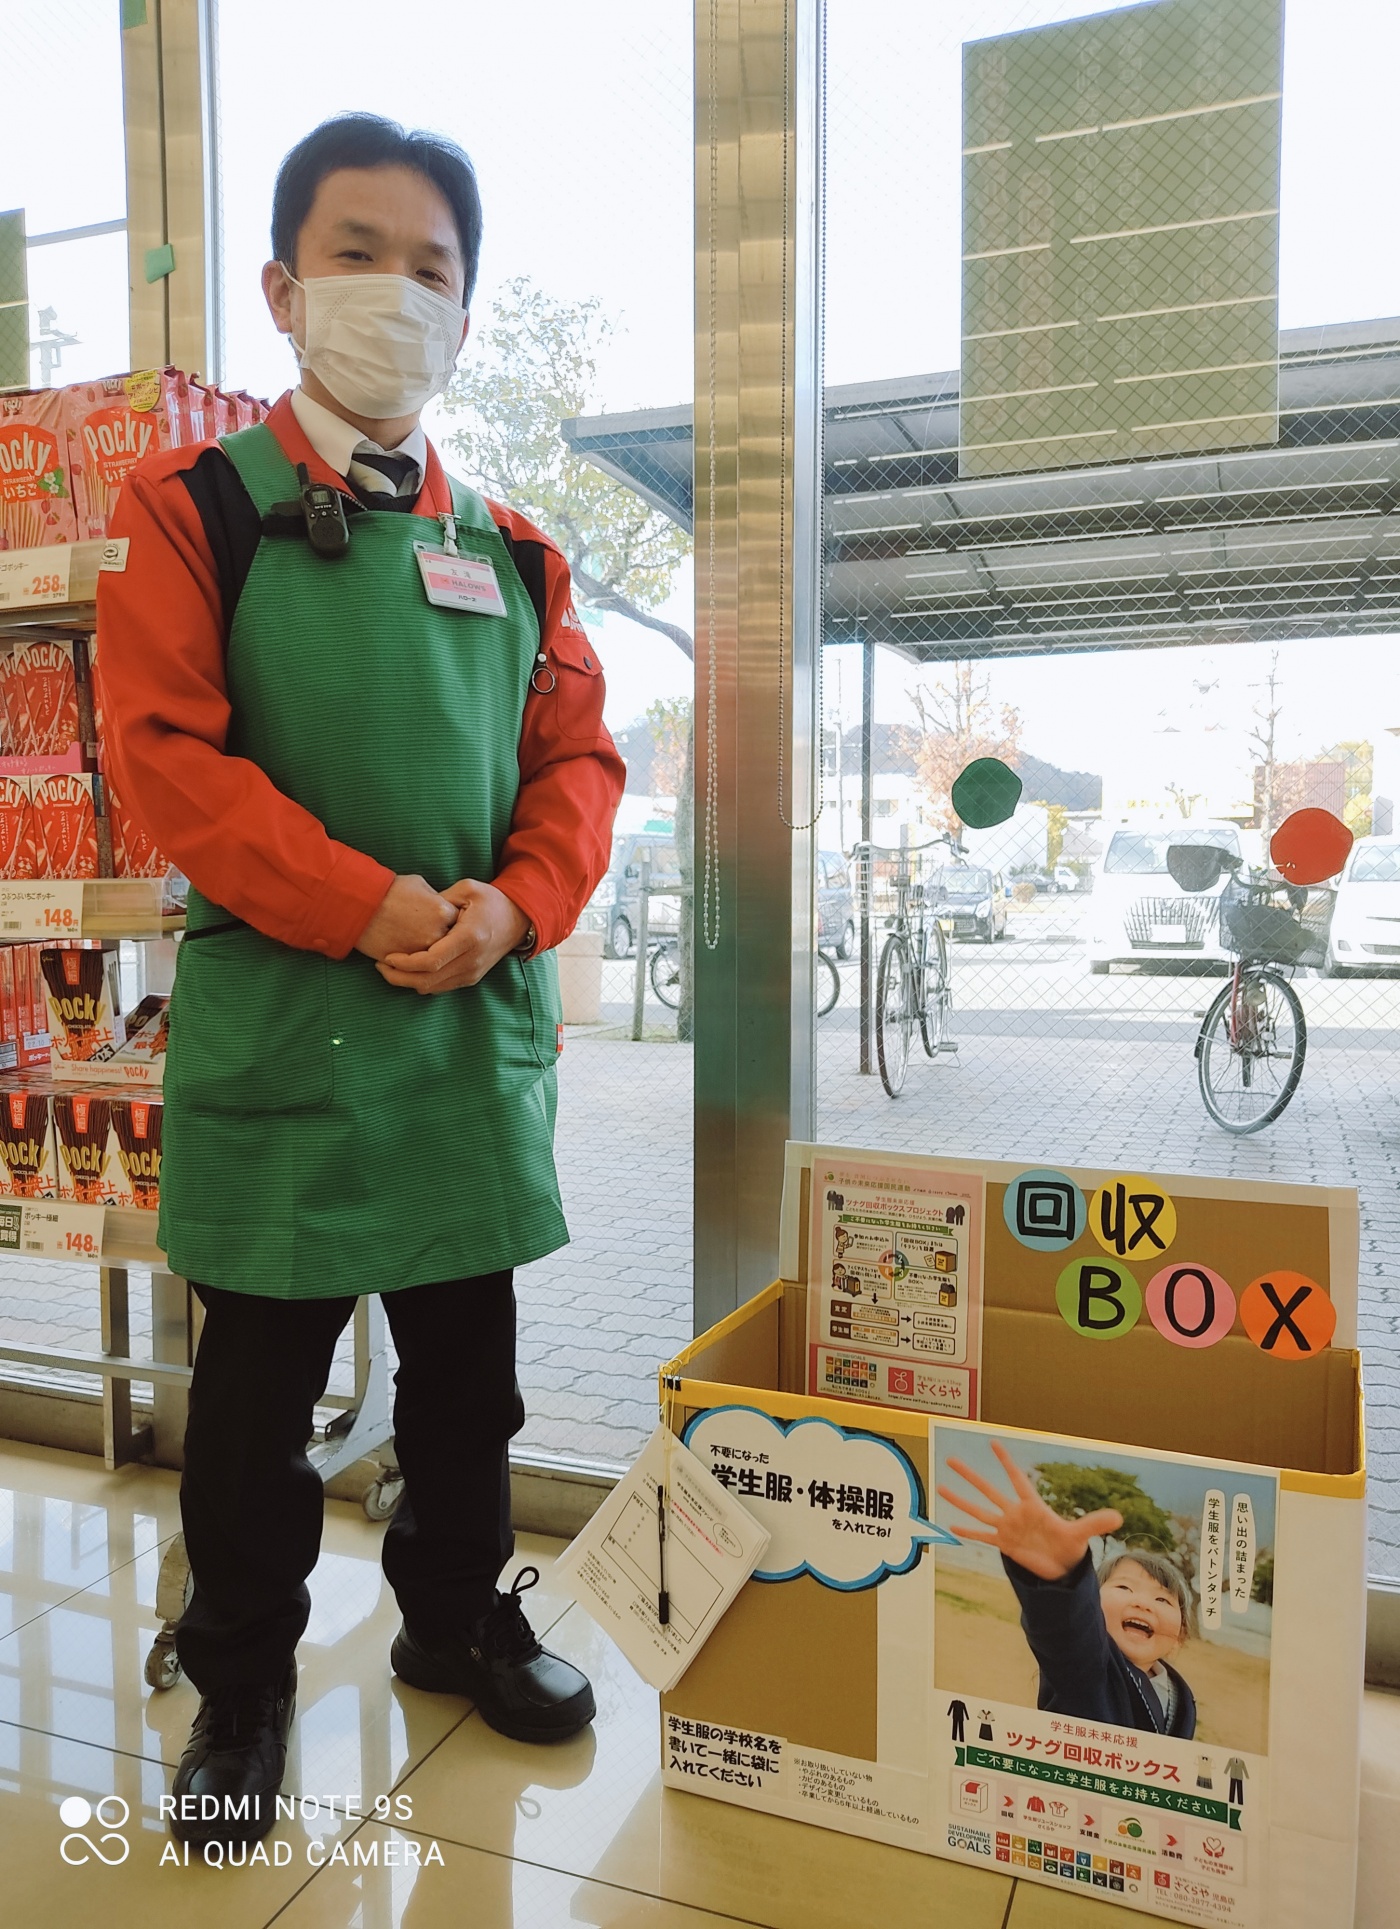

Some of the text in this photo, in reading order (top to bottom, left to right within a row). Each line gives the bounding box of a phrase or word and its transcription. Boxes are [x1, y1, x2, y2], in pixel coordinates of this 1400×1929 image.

[4, 483, 37, 499] いちご
[452, 580, 486, 592] HALOWS
[71, 1064, 89, 1072] Share
[118, 1149, 162, 1178] Pock
[24, 1213, 59, 1222] ポッキー極細
[1017, 1180, 1166, 1255] 回収
[1078, 1265, 1312, 1352] BOX
[917, 1381, 961, 1400] さくらや
[710, 1444, 769, 1464] 不要になった
[711, 1464, 894, 1521] 学生服・体操服
[832, 1519, 892, 1538] を入れてね!
[1206, 1498, 1220, 1617] 学生服をバトンタッチ
[1235, 1502, 1248, 1599] 思い出の詰まった
[668, 1716, 782, 1755] 学生服の学校名を
[1050, 1720, 1138, 1748] 学生服未来応援
[668, 1736, 779, 1773] 書いて一緒に袋に
[1007, 1731, 1181, 1783] ツナグ回収ボックス
[670, 1756, 762, 1788] 入れてください
[976, 1753, 1217, 1816] ご不要になった学生服をお持ちください
[1001, 1811, 1014, 1819] 回収
[1023, 1815, 1071, 1830] 学生服リユースショップ
[948, 1823, 991, 1839] SUSTAINABLE
[948, 1830, 991, 1844] DEVELOPMENT
[1037, 1824, 1055, 1832] さくらや
[1079, 1829, 1100, 1839] 支援金
[947, 1836, 991, 1855] GOALS
[1161, 1849, 1183, 1860] 活動費
[1174, 1881, 1209, 1898] さくらや
